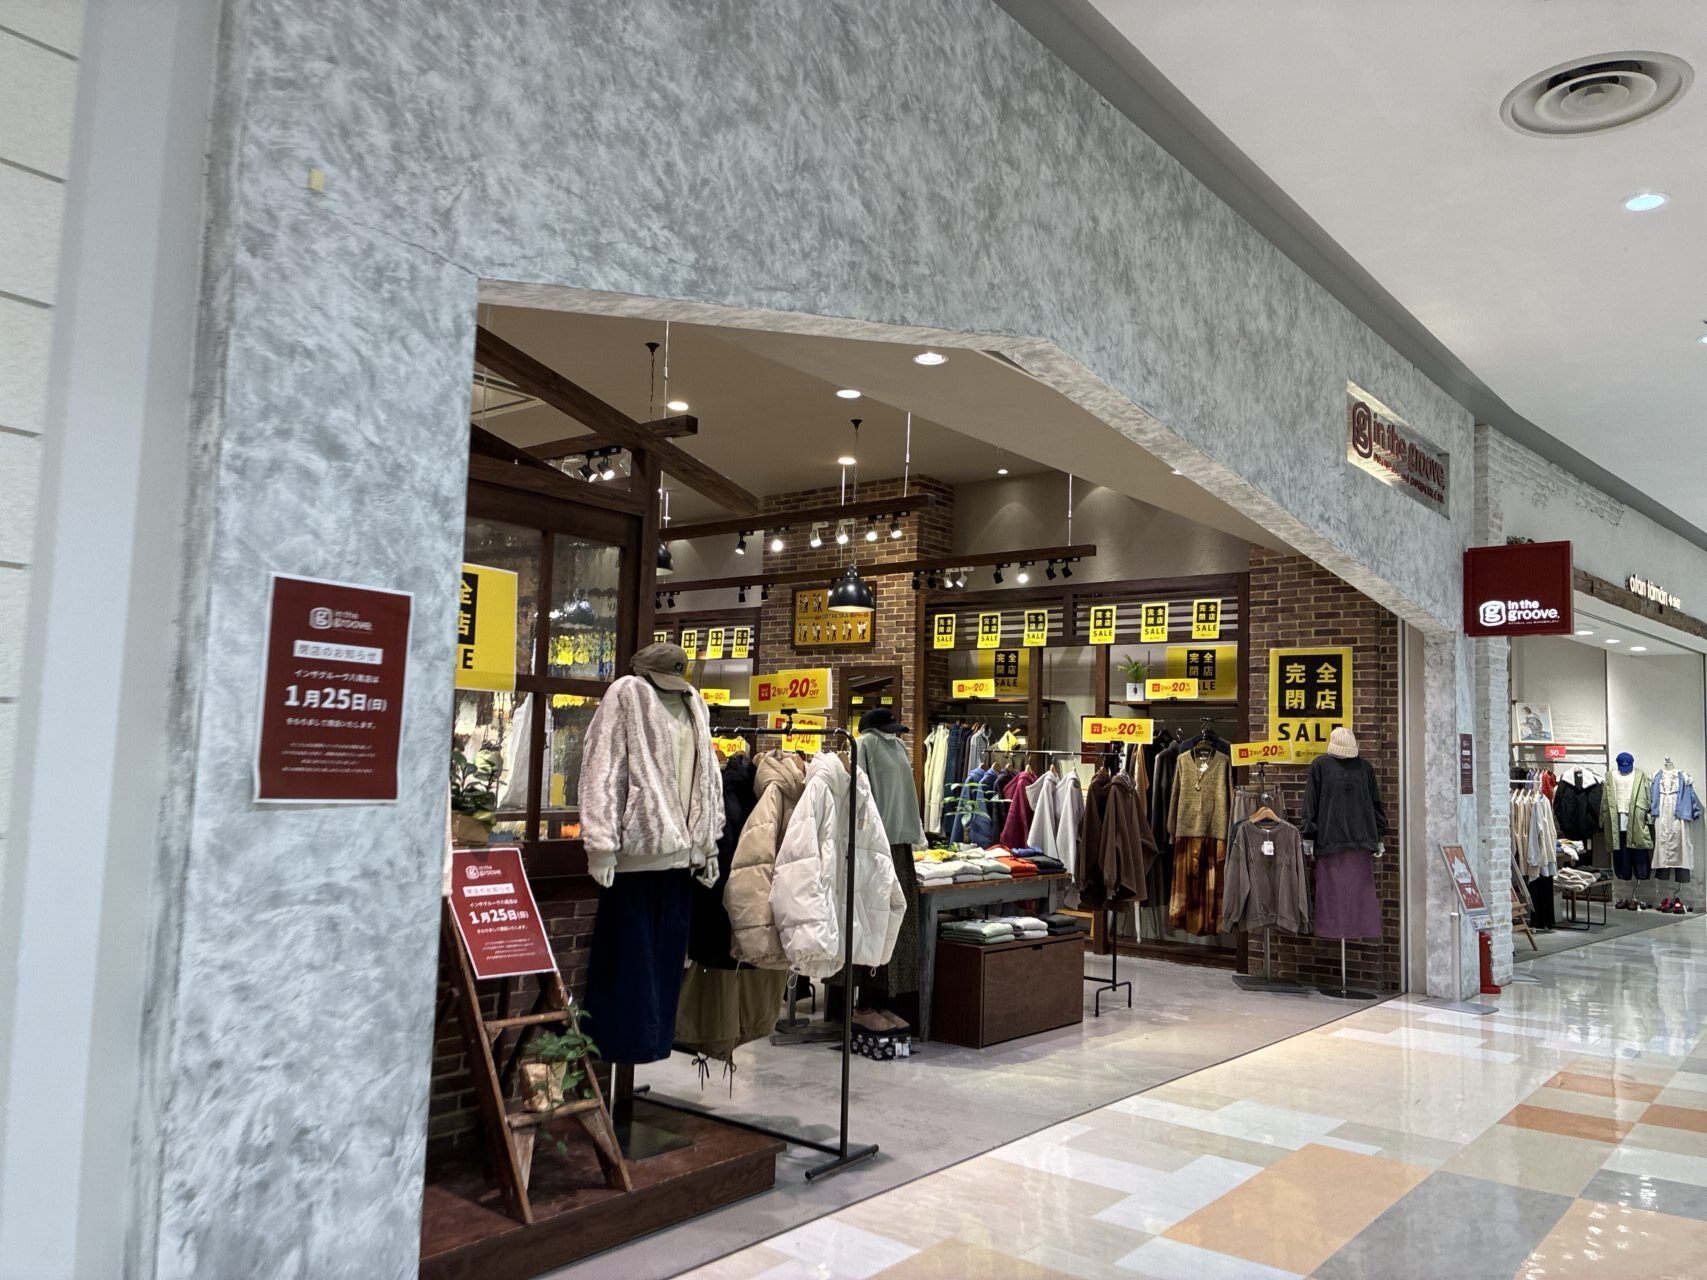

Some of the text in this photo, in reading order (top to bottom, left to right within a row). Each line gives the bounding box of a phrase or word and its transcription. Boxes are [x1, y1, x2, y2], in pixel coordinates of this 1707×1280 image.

[1374, 413, 1386, 451] in
[1387, 423, 1406, 462] the
[1199, 604, 1216, 613] 完全
[1508, 599, 1540, 610] in the
[1147, 608, 1164, 616] 完全
[1144, 628, 1166, 636] SALE
[1196, 624, 1218, 632] SALE
[980, 634, 998, 642] SALE
[1026, 632, 1045, 640] SALE
[996, 653, 1017, 663] 完全
[1189, 652, 1214, 664] 完全
[1188, 666, 1214, 678] 閉店
[1285, 662, 1338, 684] 完全
[1285, 689, 1337, 710] 閉店
[1278, 722, 1344, 742] SAL
